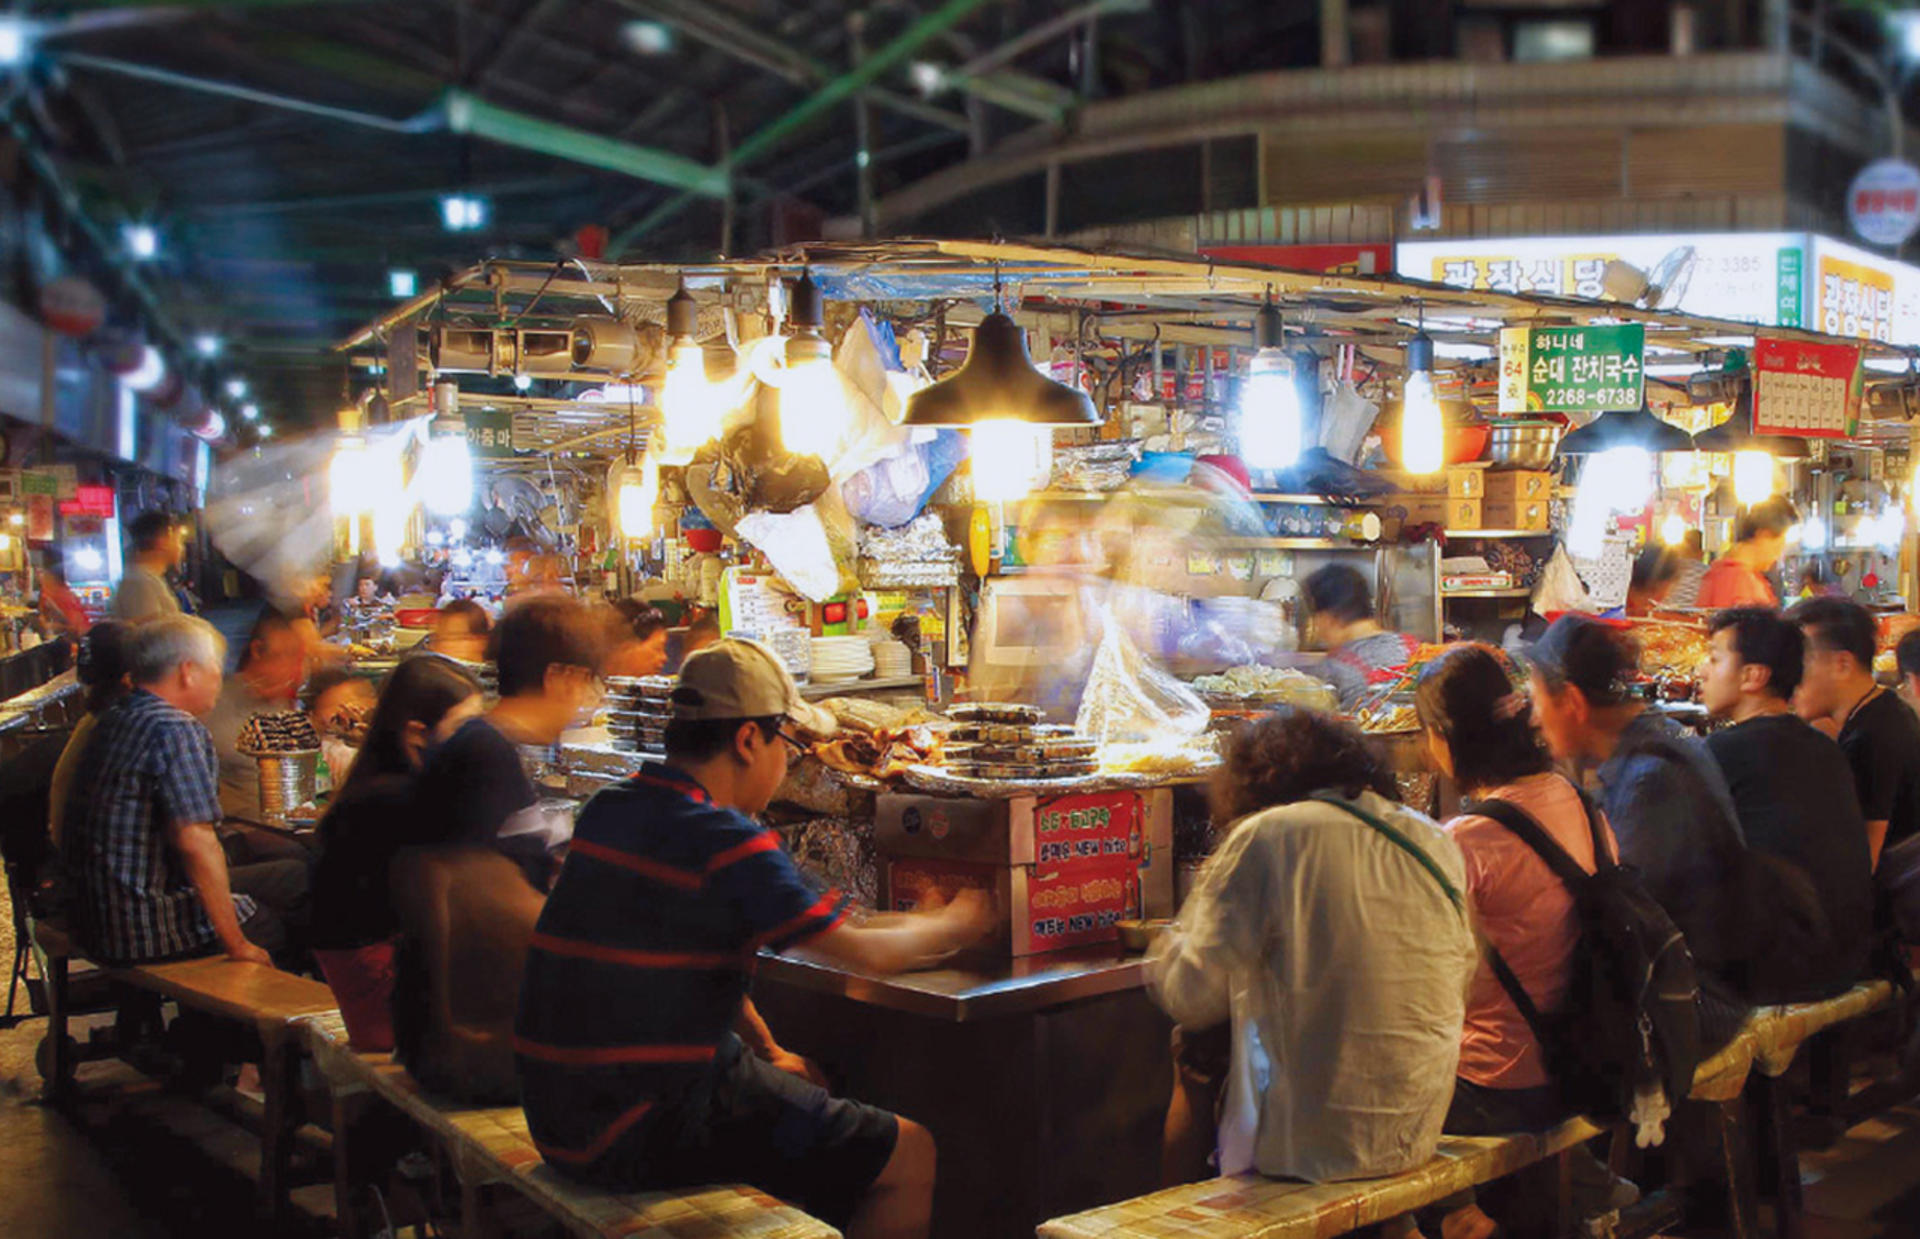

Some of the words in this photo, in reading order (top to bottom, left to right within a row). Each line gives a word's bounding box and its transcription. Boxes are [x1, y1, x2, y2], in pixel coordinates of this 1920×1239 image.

[1442, 259, 1605, 299] 광장식당
[1823, 271, 1893, 341] 광장식당
[1536, 333, 1584, 350] 하니네
[1504, 360, 1523, 377] 64
[1533, 355, 1565, 384] 순대
[1571, 353, 1640, 384] 잔치국수
[1546, 387, 1637, 406] 2268-6738
